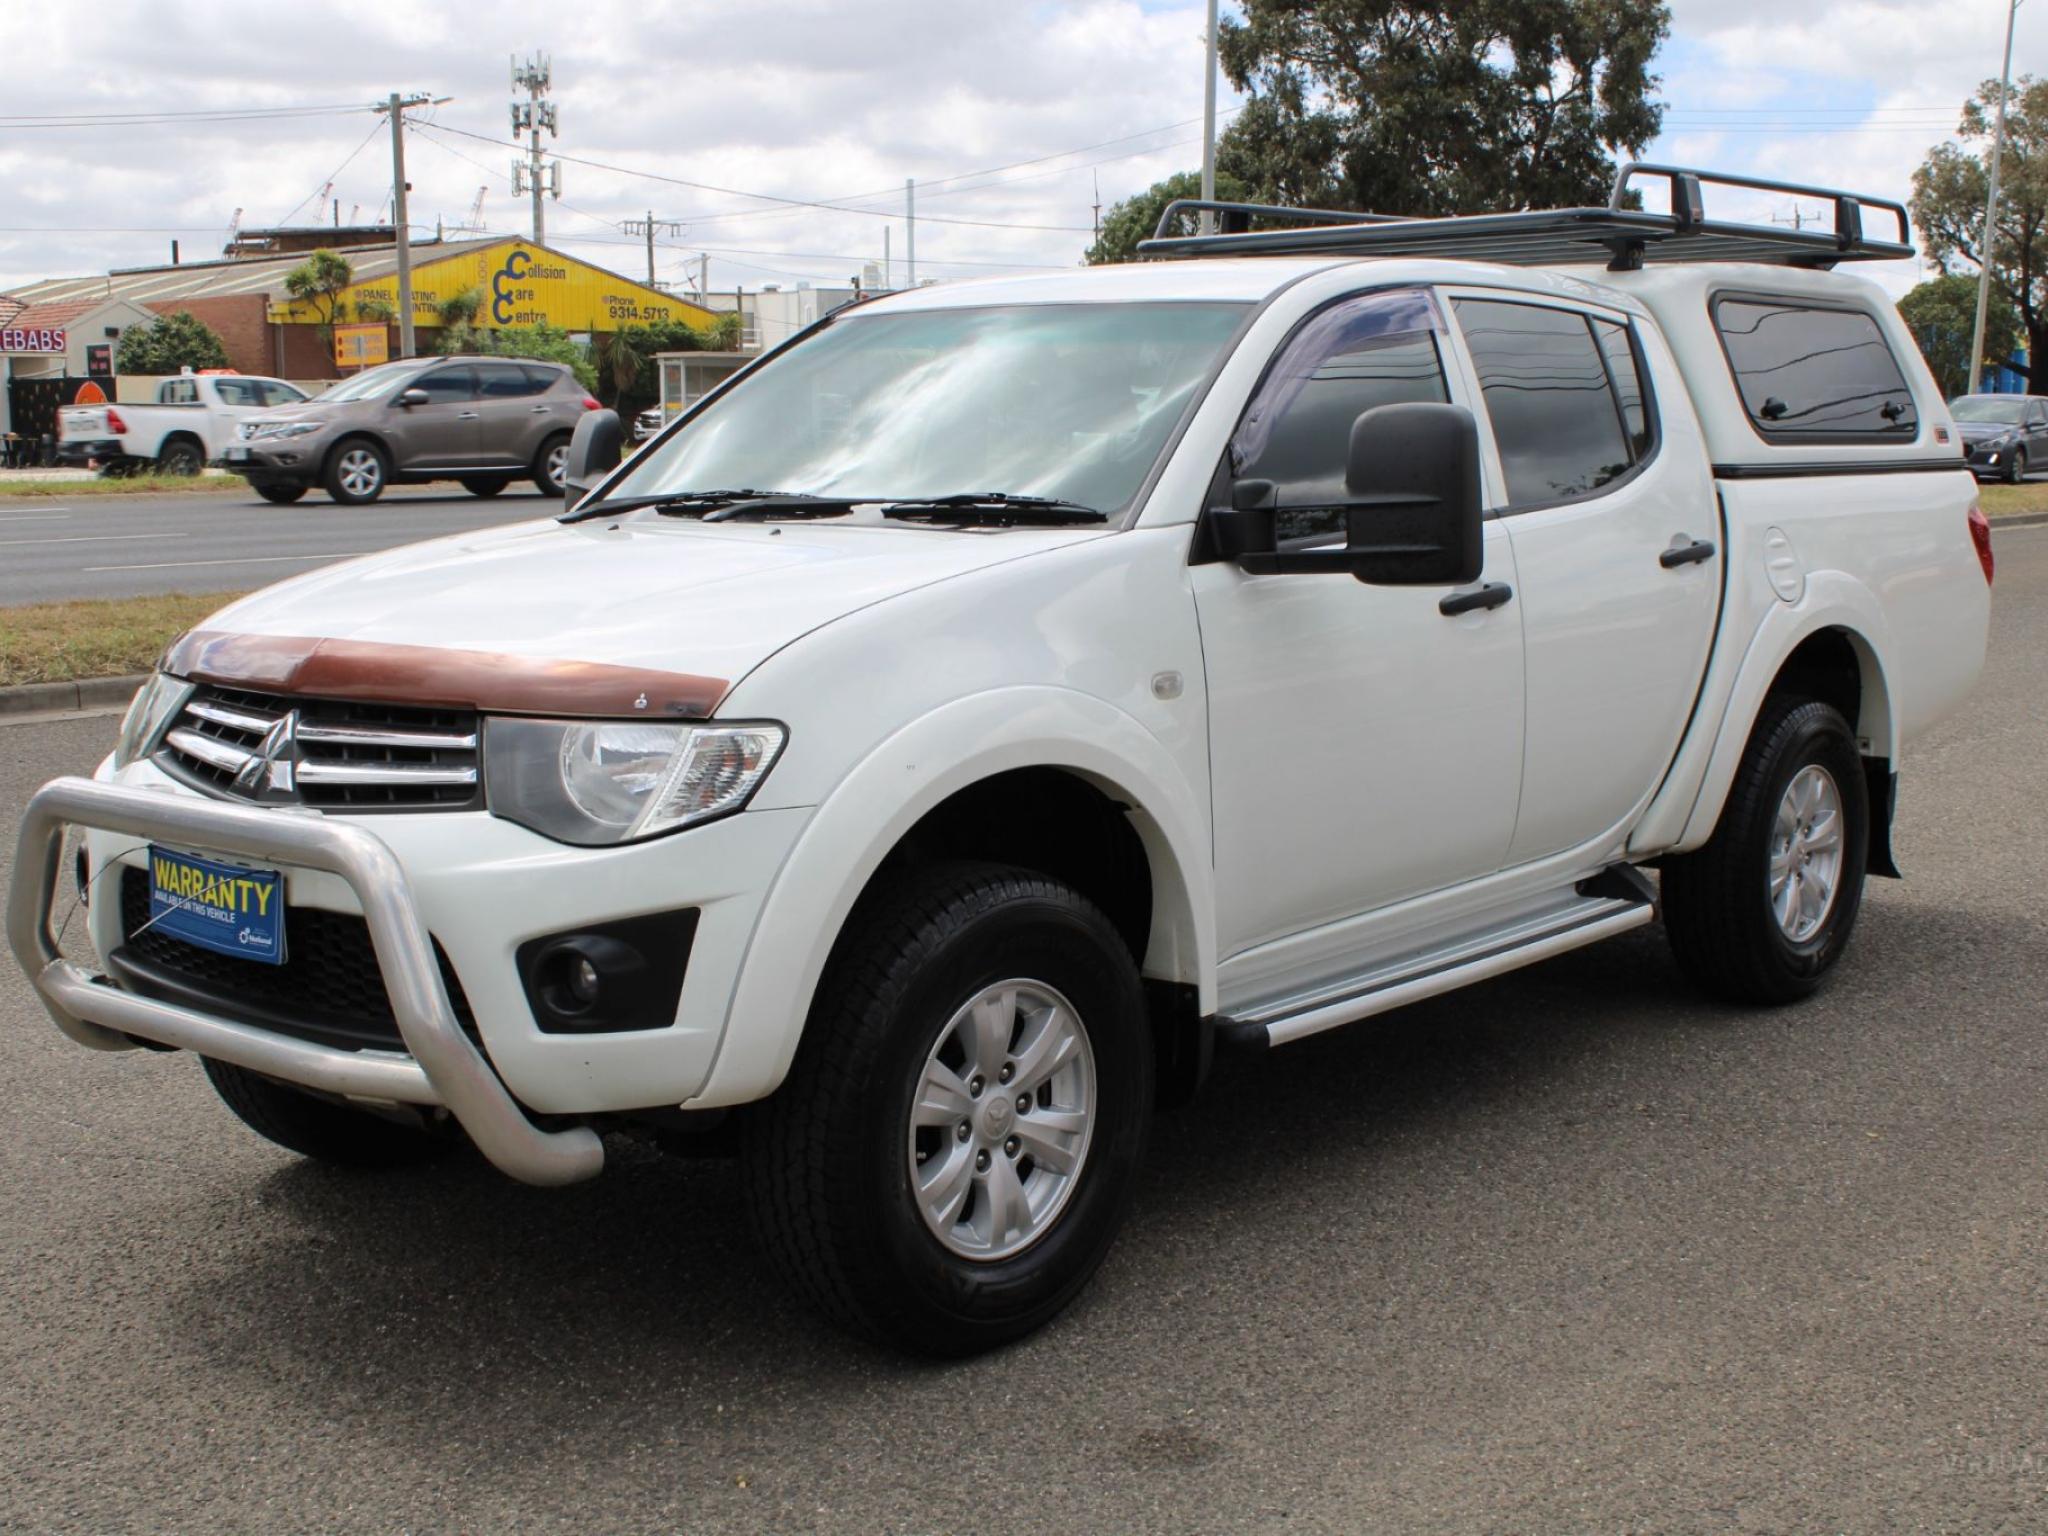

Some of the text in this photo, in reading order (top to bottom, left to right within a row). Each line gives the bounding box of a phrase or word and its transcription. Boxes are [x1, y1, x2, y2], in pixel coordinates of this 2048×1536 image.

[506, 251, 566, 279] Collision
[363, 289, 393, 301] PANEL
[493, 269, 534, 305] Care
[609, 306, 670, 320] 9314.5713
[0, 329, 65, 351] EBABS
[153, 857, 273, 916] WARRANTY
[206, 907, 236, 924] VEHICLE
